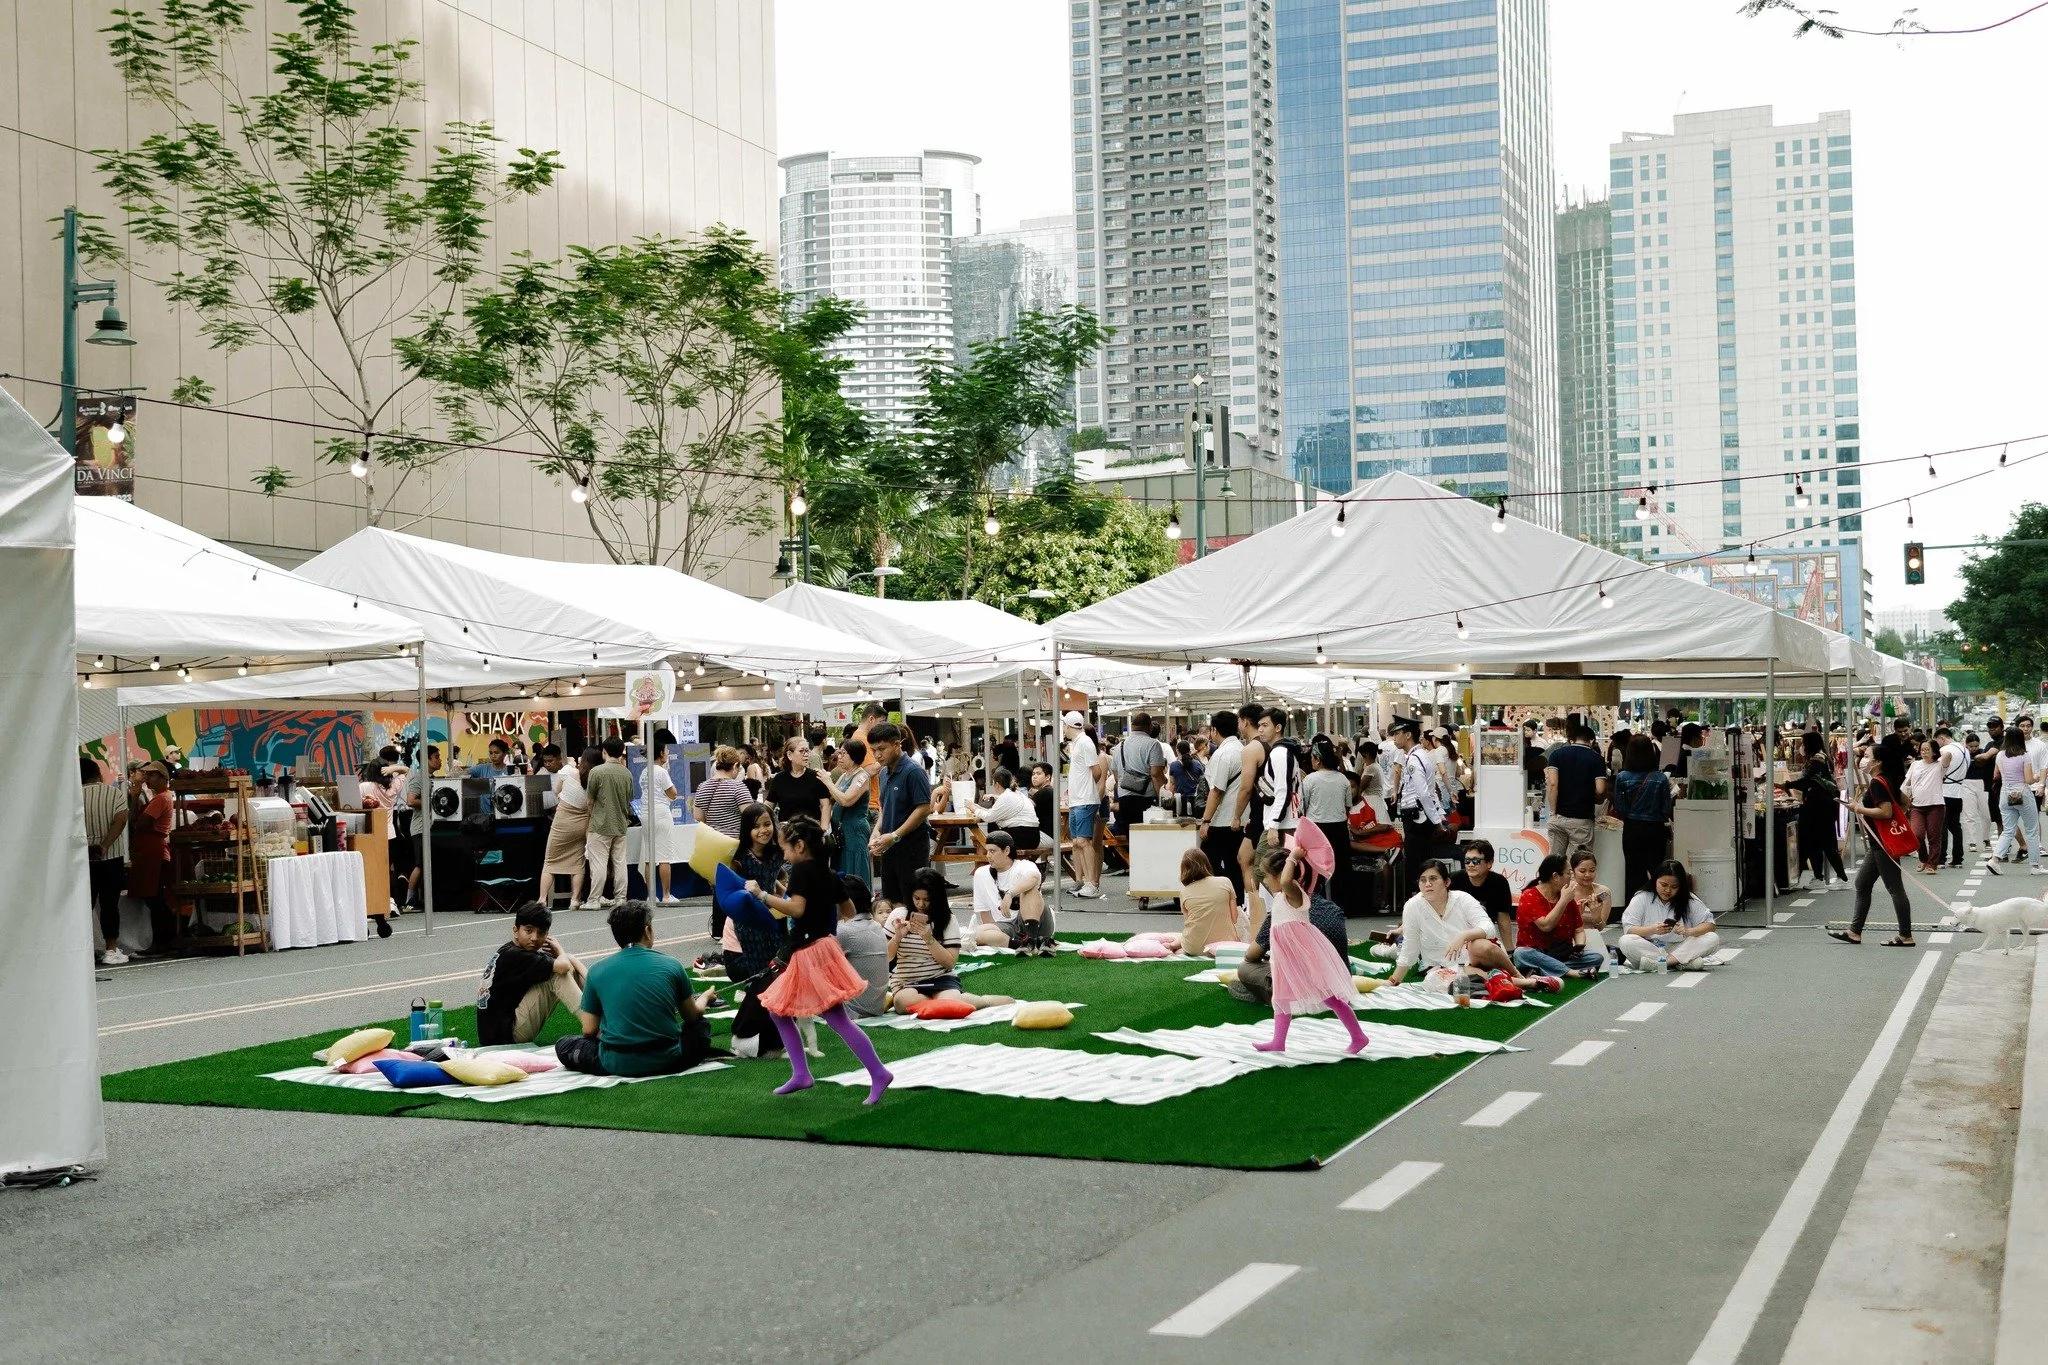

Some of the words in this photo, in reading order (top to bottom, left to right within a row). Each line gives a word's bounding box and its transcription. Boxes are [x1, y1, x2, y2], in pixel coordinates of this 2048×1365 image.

[77, 470, 94, 481] DA
[97, 467, 133, 480] VINCI
[470, 712, 526, 735] SHACK
[1498, 847, 1535, 864] BGC
